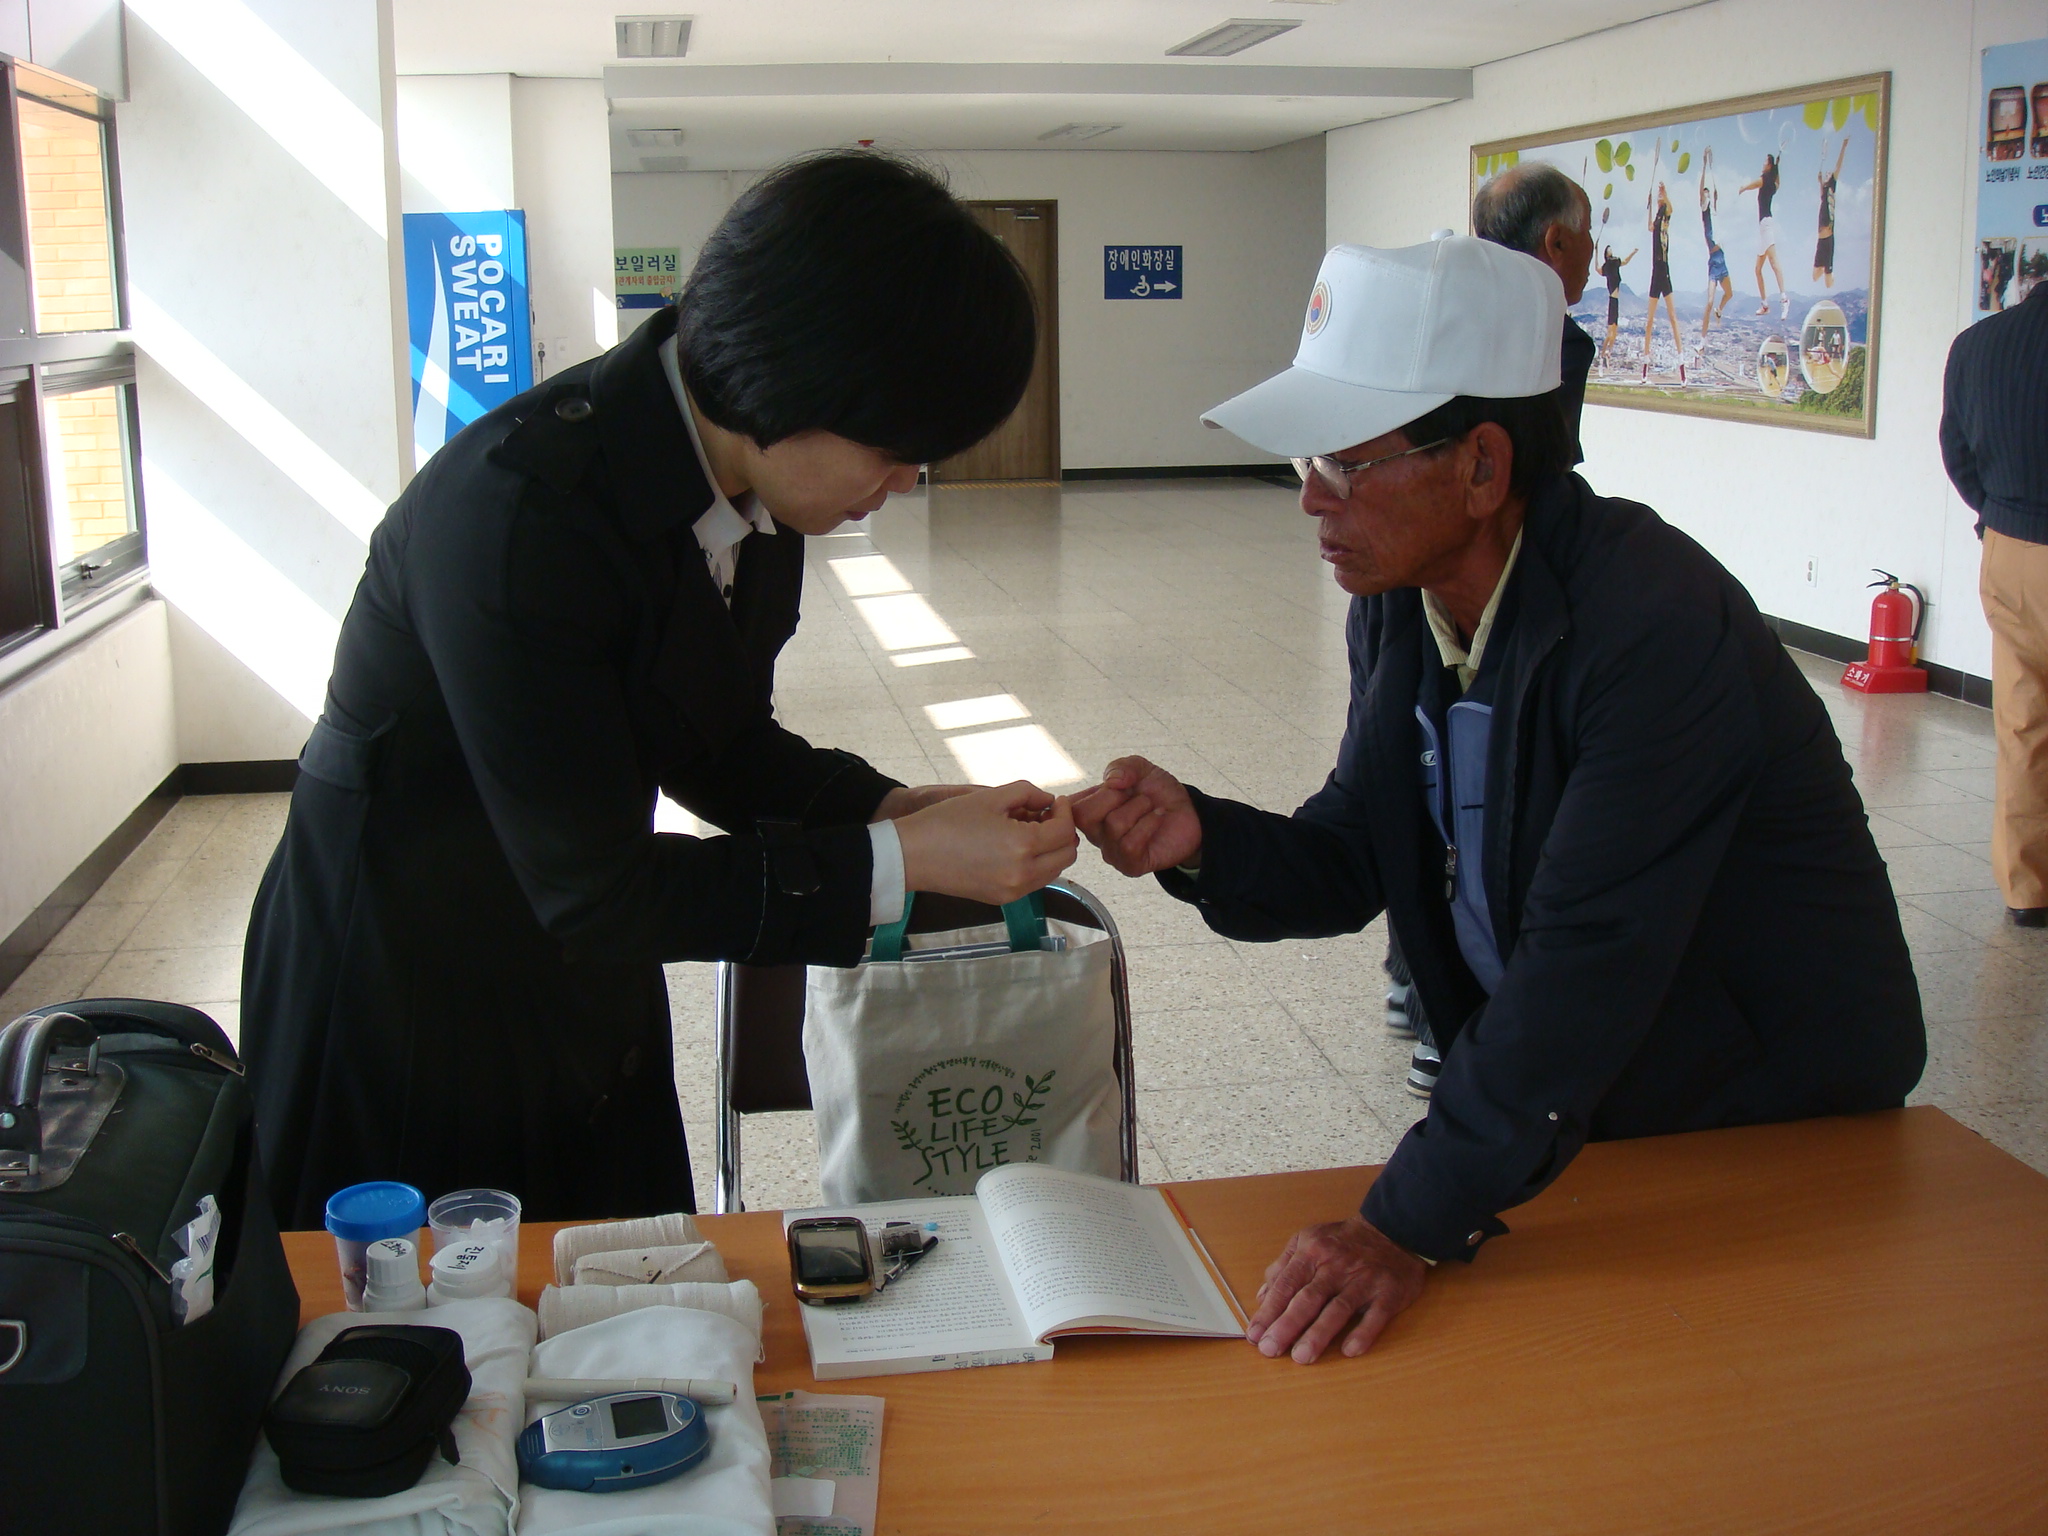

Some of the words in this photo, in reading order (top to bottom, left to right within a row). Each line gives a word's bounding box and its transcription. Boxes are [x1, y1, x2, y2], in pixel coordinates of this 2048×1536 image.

[615, 254, 676, 272] 보일러실
[1108, 249, 1174, 271] 장애인화장실
[450, 235, 482, 372] SWEAT
[476, 234, 510, 383] POCARI
[1846, 667, 1870, 684] 소화기
[927, 1084, 1003, 1118] ECO
[931, 1117, 1000, 1143] LIFE
[912, 1141, 1010, 1185] STYLE
[319, 1384, 372, 1396] SONY
